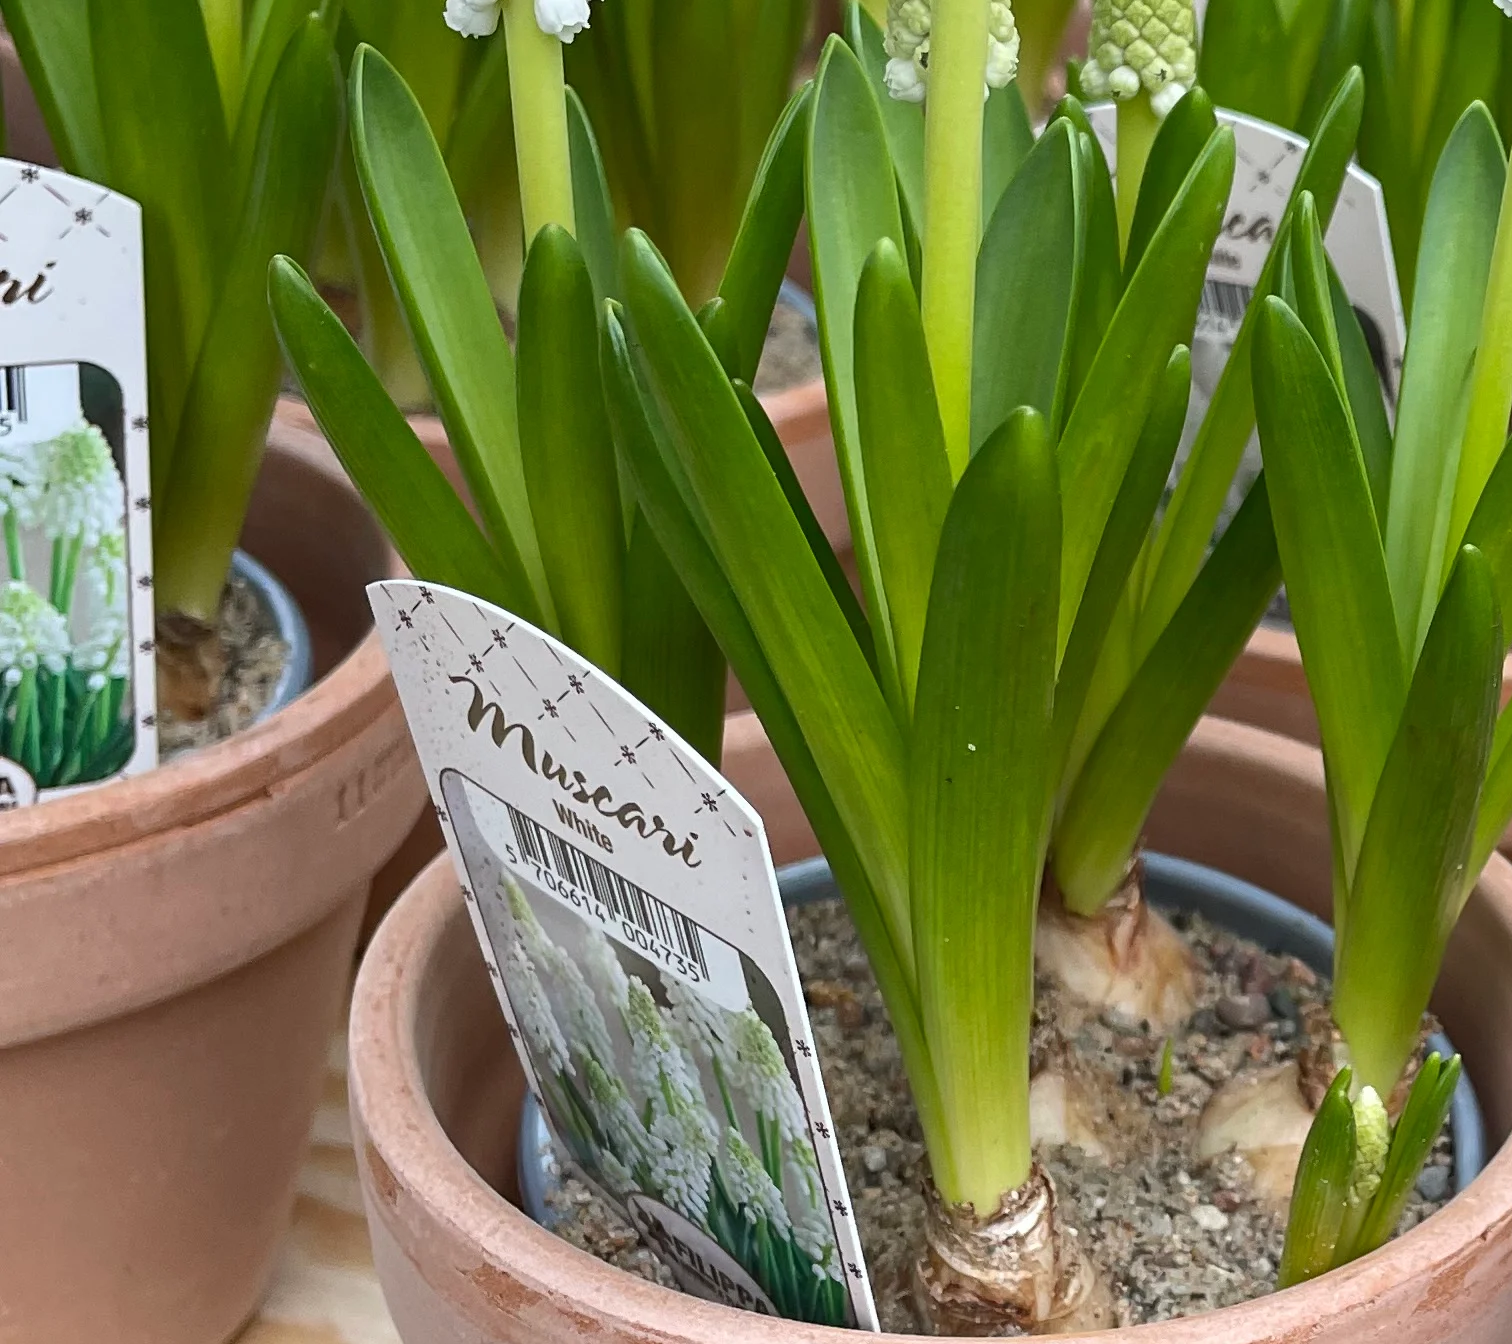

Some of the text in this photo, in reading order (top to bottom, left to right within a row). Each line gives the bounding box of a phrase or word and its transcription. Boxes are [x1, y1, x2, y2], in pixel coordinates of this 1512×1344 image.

[449, 675, 702, 868] Muscari
[552, 798, 614, 854] White
[505, 843, 700, 983] 5 706614 004735
